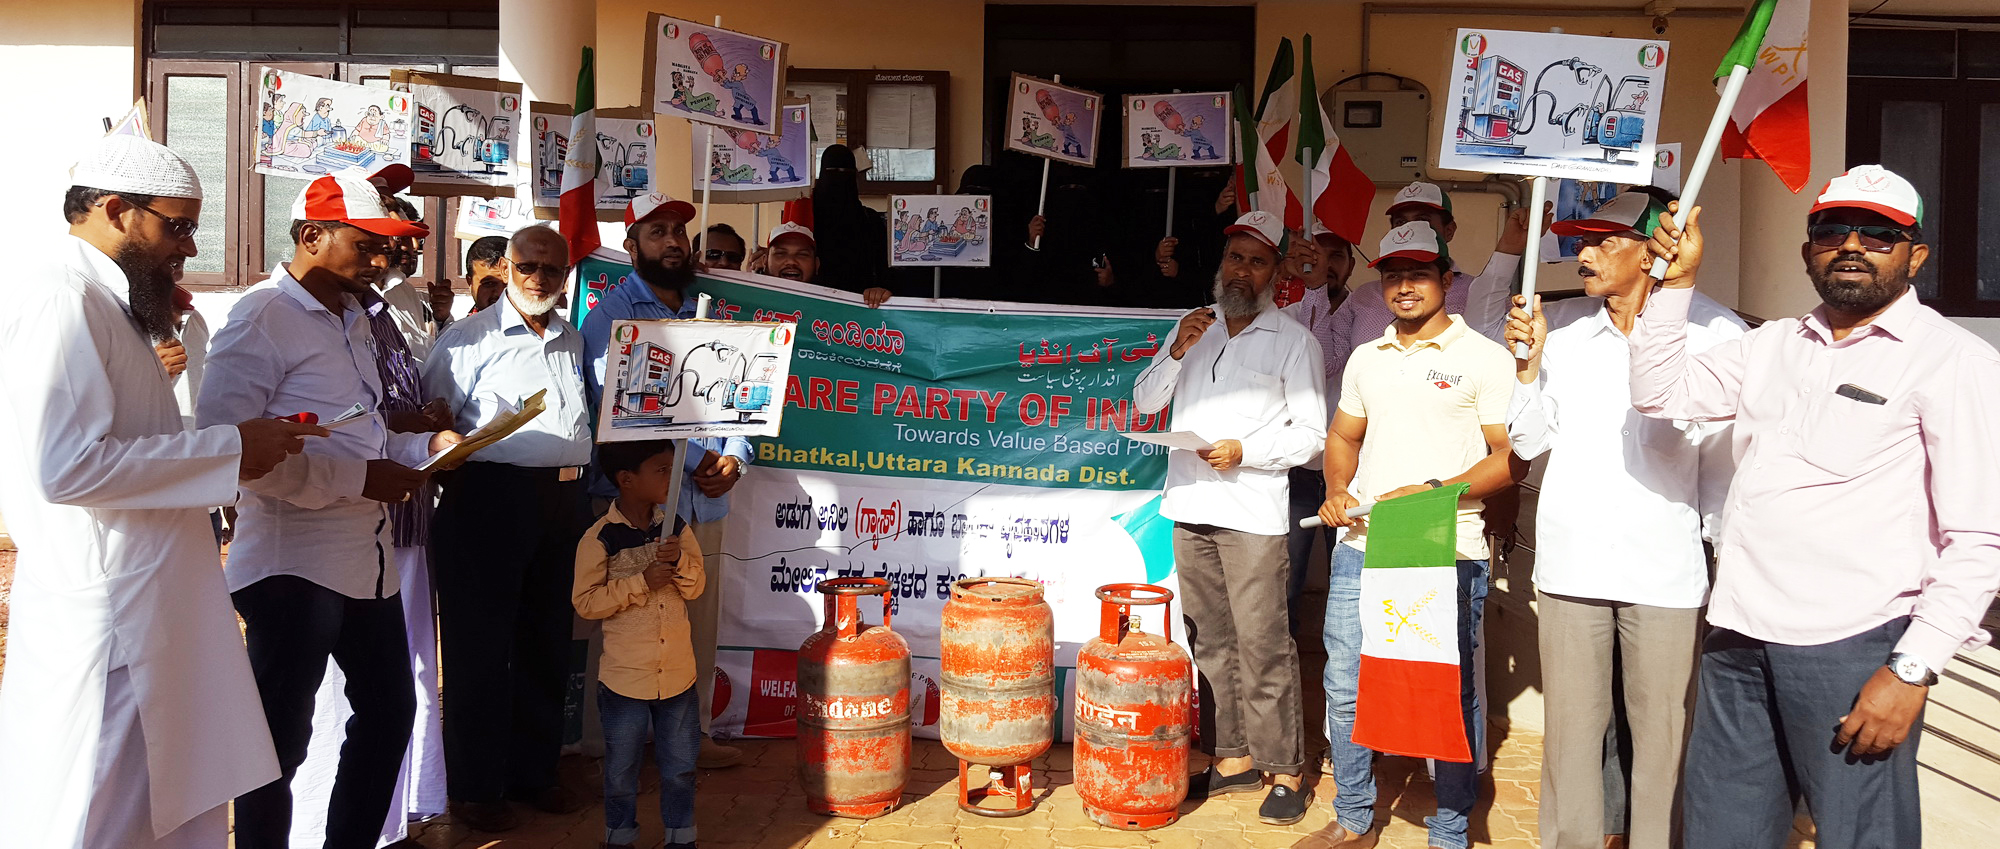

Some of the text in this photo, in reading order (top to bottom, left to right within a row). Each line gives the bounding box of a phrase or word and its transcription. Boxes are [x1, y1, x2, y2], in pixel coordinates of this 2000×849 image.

[1759, 46, 1795, 86] WPI
[690, 96, 711, 106] PEOPLE
[557, 137, 567, 147] GA
[728, 167, 747, 178] PEOPLE
[811, 319, 905, 355] ಇಂಡಿಯಾ
[1426, 369, 1463, 386] EXCLUSIF
[873, 383, 1007, 424] PARTY
[1018, 393, 1073, 428] OF
[1085, 397, 1172, 433] INDI
[893, 423, 980, 446] Towards
[988, 430, 1046, 451] Value
[1053, 434, 1120, 455] Based
[957, 457, 1070, 482] Kannada
[1079, 465, 1136, 485] Dist.
[775, 496, 814, 530] ಅಡುಗೆ
[818, 503, 848, 531] ಅನಿಲ
[1382, 599, 1394, 643] WPI
